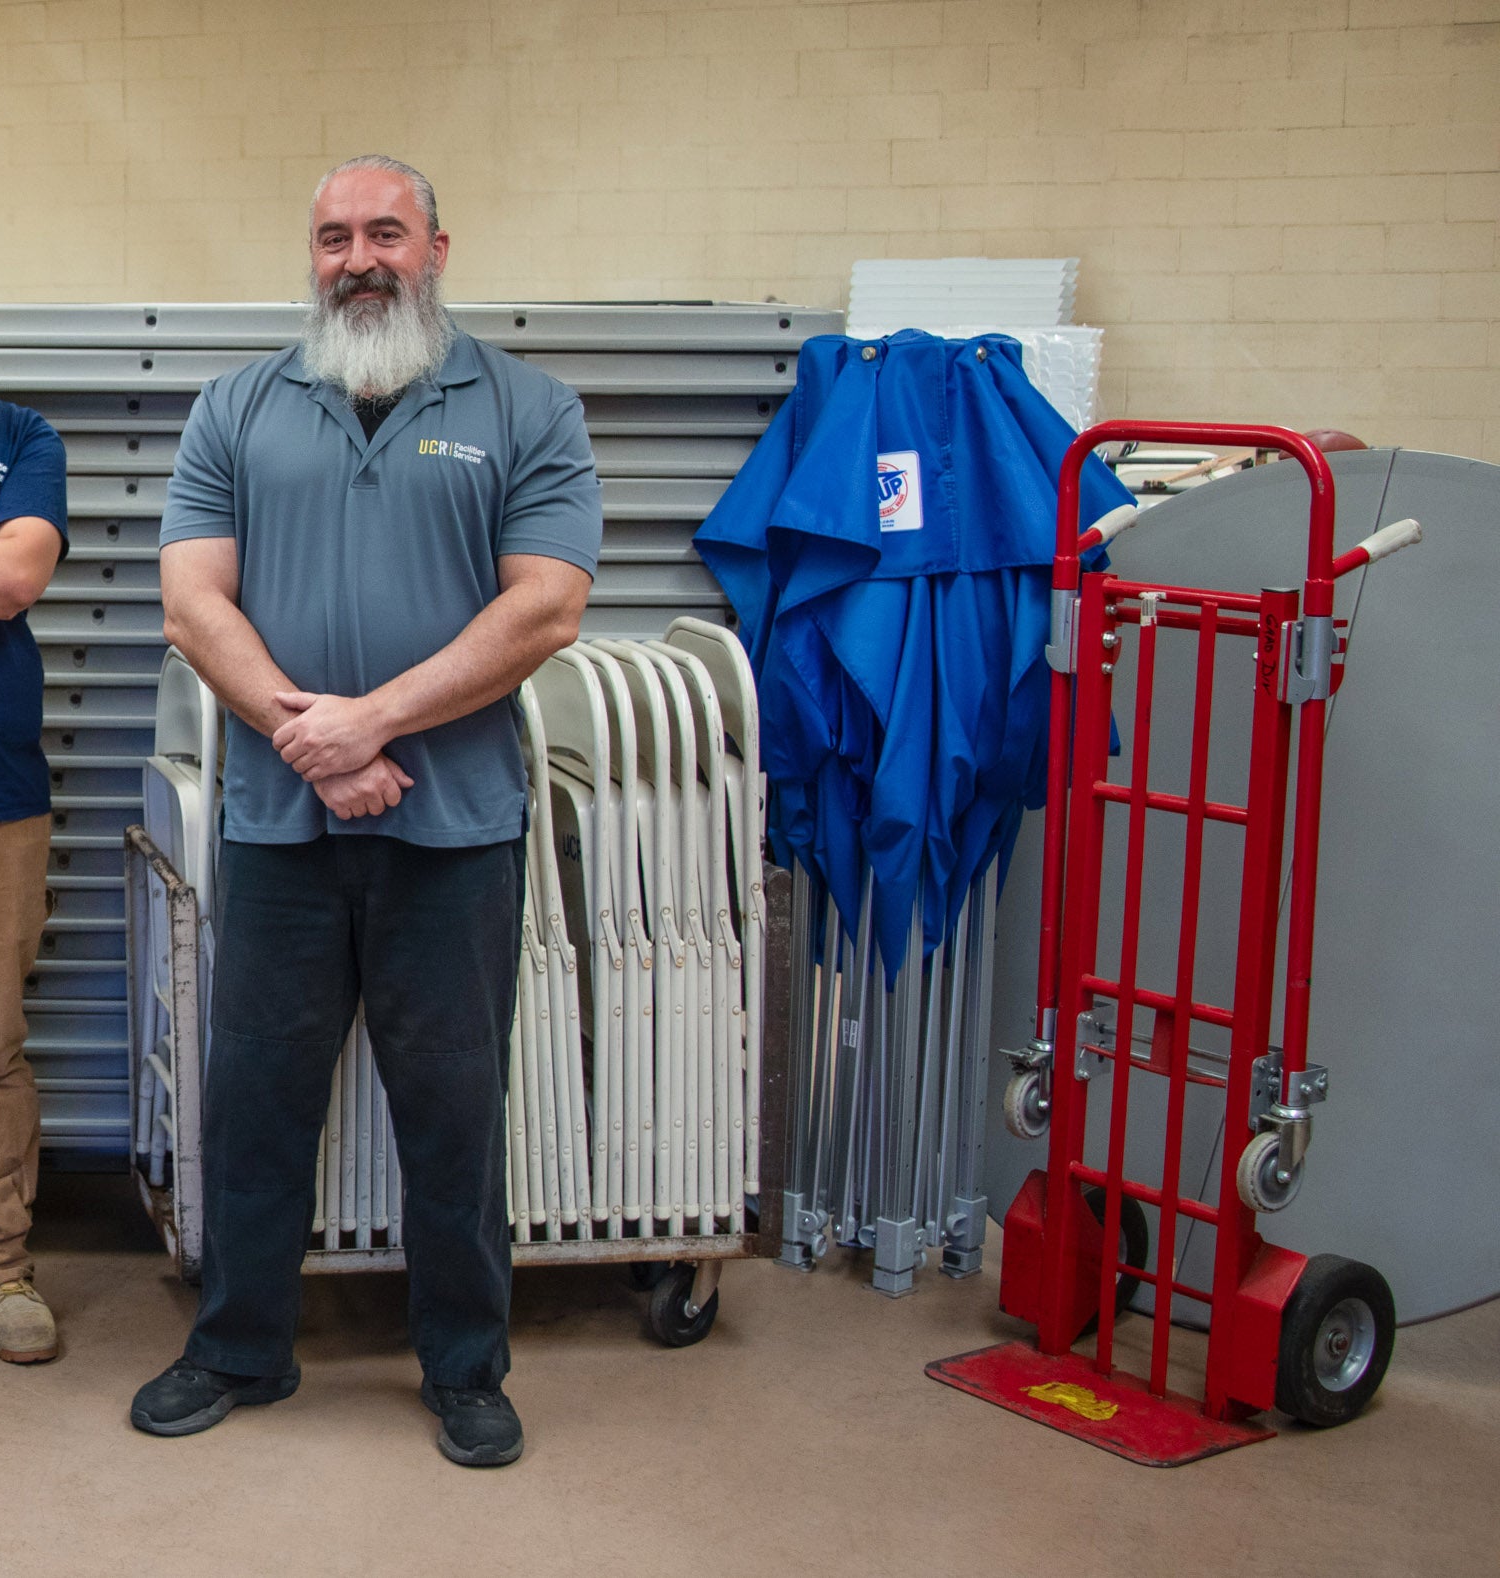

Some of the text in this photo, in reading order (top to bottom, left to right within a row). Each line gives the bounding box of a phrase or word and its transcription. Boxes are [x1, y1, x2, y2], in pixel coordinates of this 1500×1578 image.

[418, 438, 449, 456] UCR
[453, 441, 486, 457] Facilities
[452, 449, 481, 465] Services
